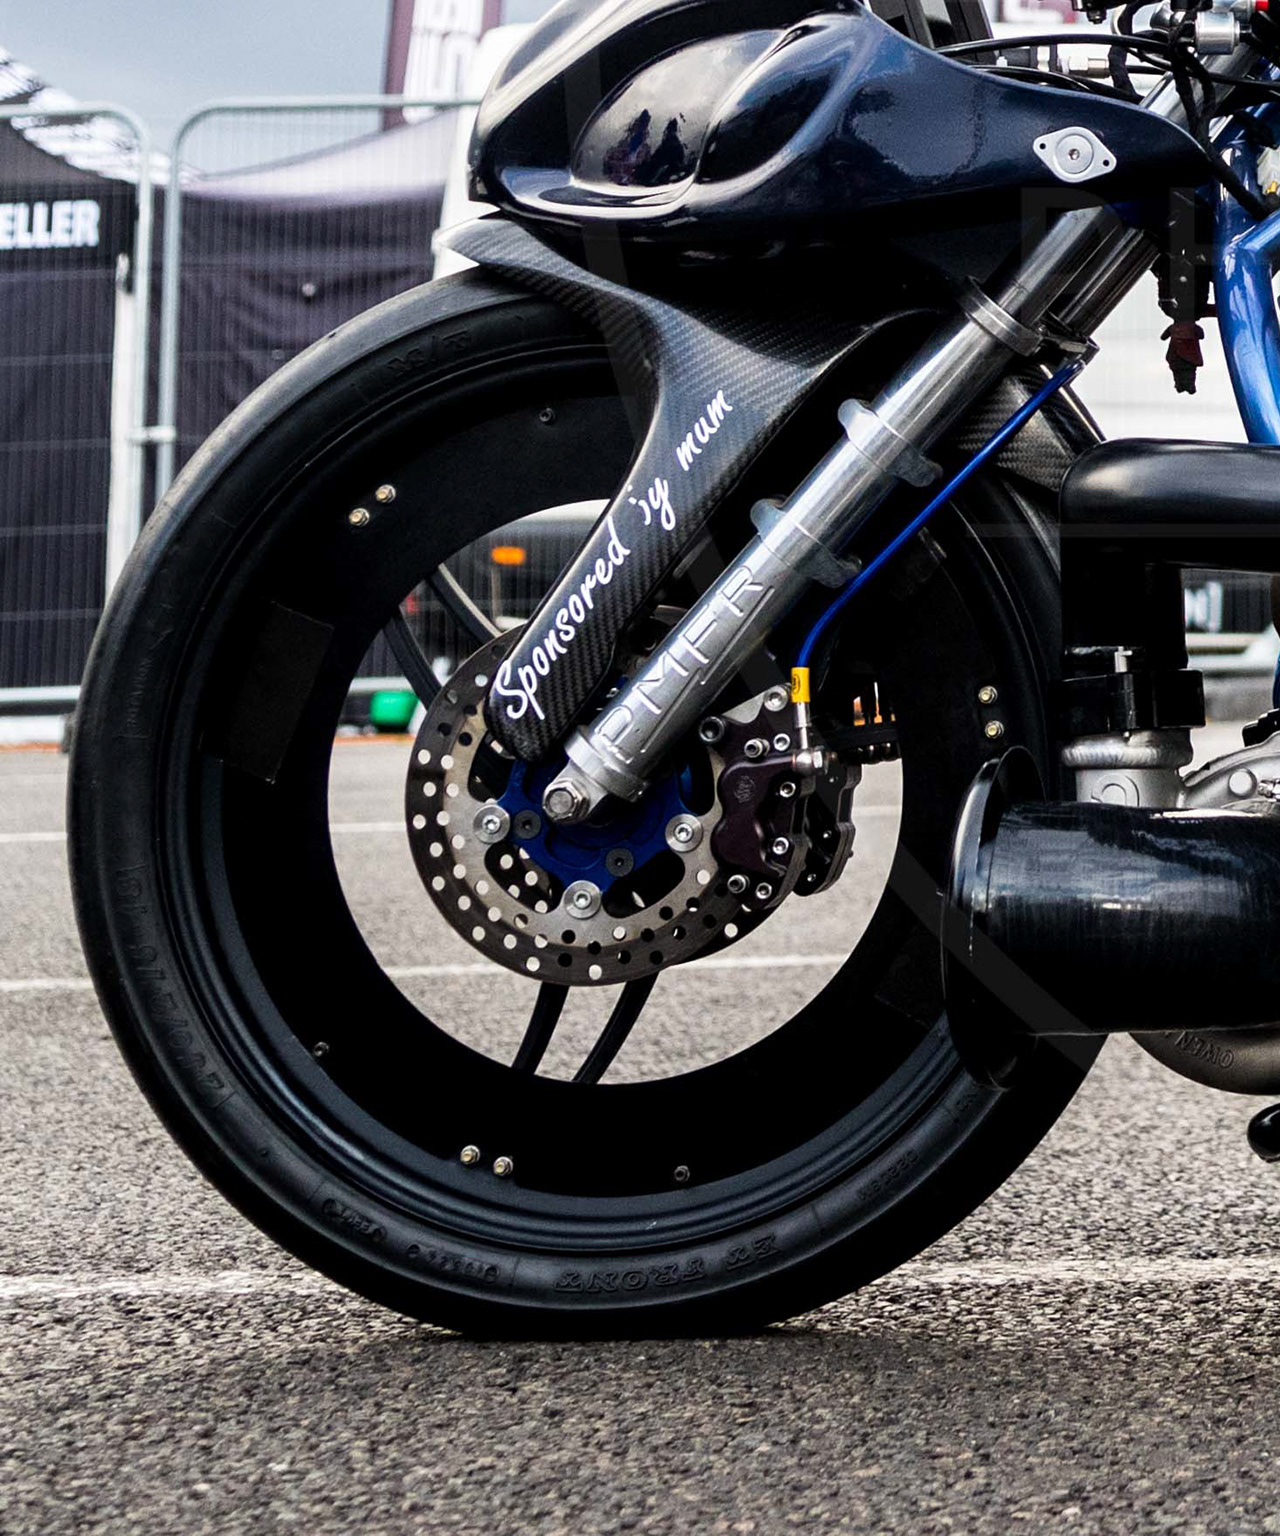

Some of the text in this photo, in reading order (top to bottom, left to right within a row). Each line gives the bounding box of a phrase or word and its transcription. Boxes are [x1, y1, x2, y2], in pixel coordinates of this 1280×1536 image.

[490, 530, 631, 722] Sponsored
[676, 390, 734, 473] mum
[598, 564, 773, 764] PMFR
